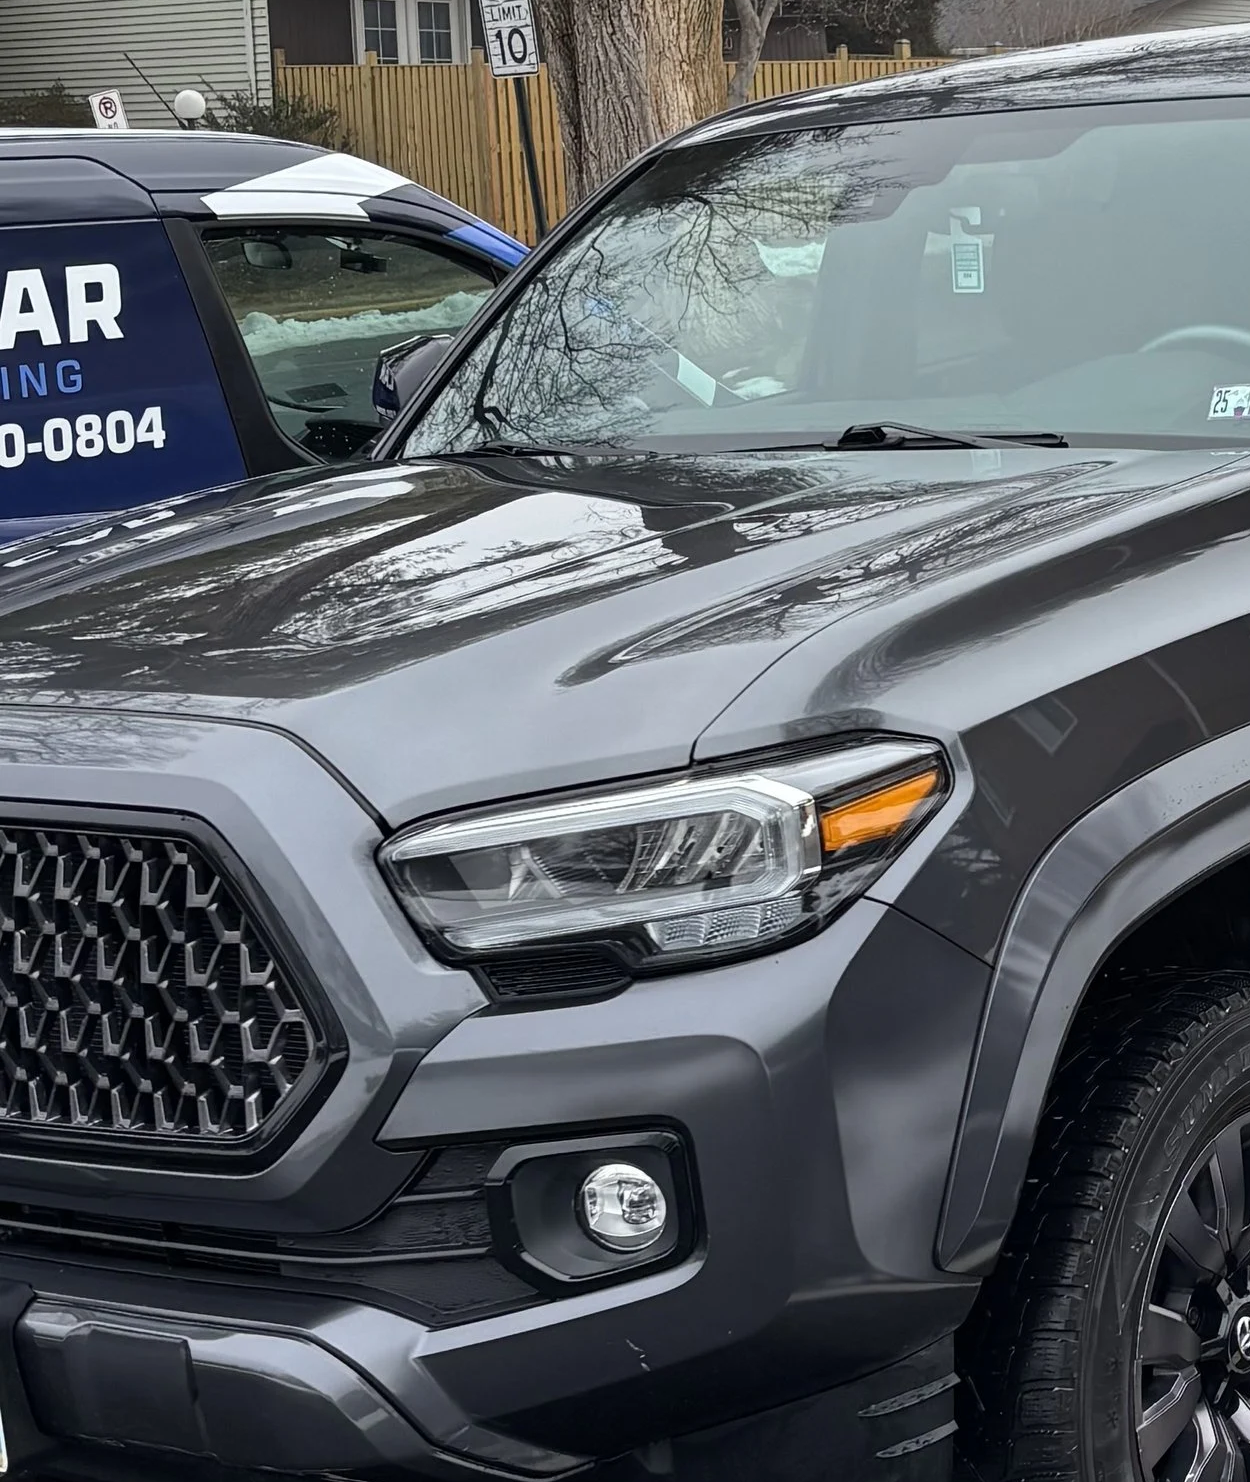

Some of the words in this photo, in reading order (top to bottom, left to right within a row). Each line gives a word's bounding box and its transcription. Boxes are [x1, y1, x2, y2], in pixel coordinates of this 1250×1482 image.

[490, 6, 523, 21] LIMIT
[495, 28, 527, 65] 10
[0, 263, 124, 350] AR
[0, 360, 83, 400] ING
[1213, 390, 1231, 414] 25
[0, 406, 166, 468] 0-0804
